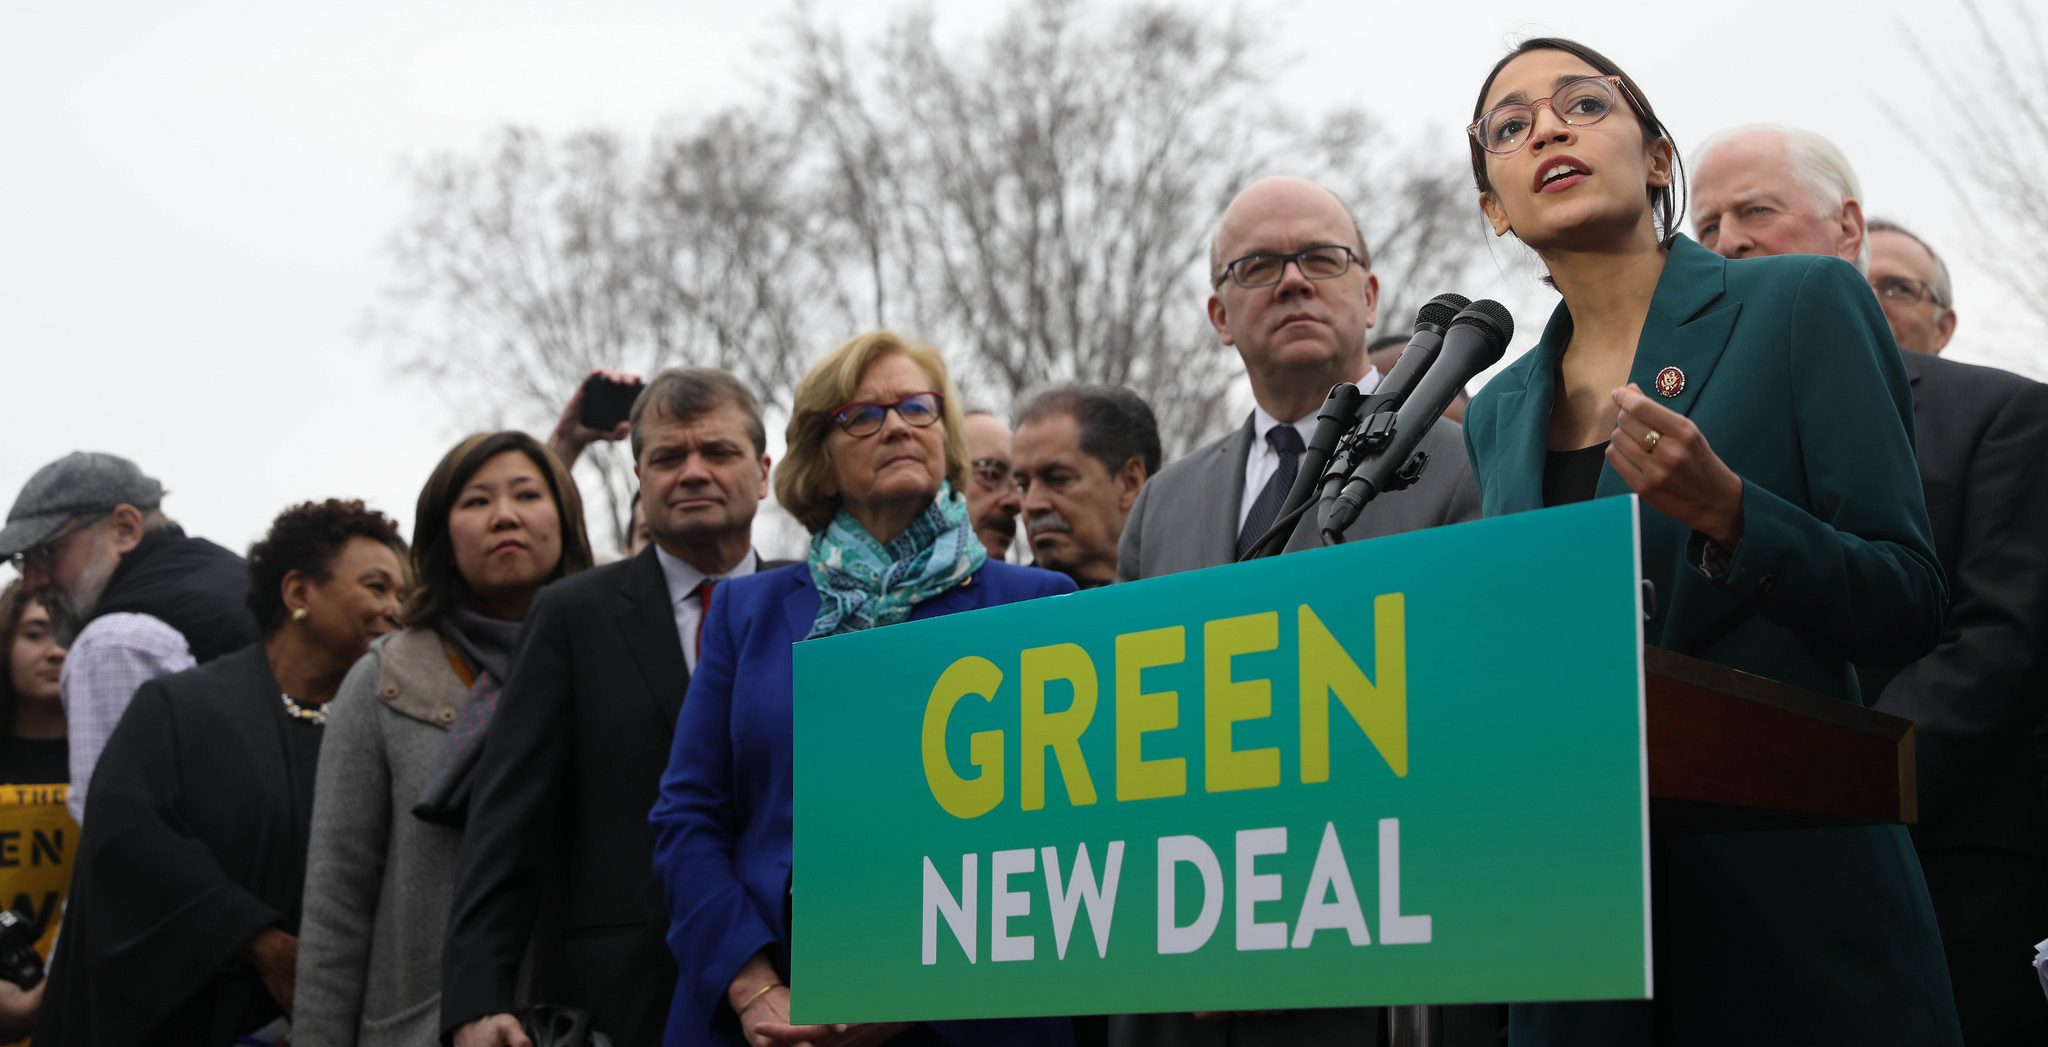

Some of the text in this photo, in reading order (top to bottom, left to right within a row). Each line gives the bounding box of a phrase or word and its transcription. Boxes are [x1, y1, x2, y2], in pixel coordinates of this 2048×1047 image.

[922, 592, 1408, 819] GREEN
[16, 789, 65, 805] THE
[921, 817, 1433, 966] NEW DEAL
